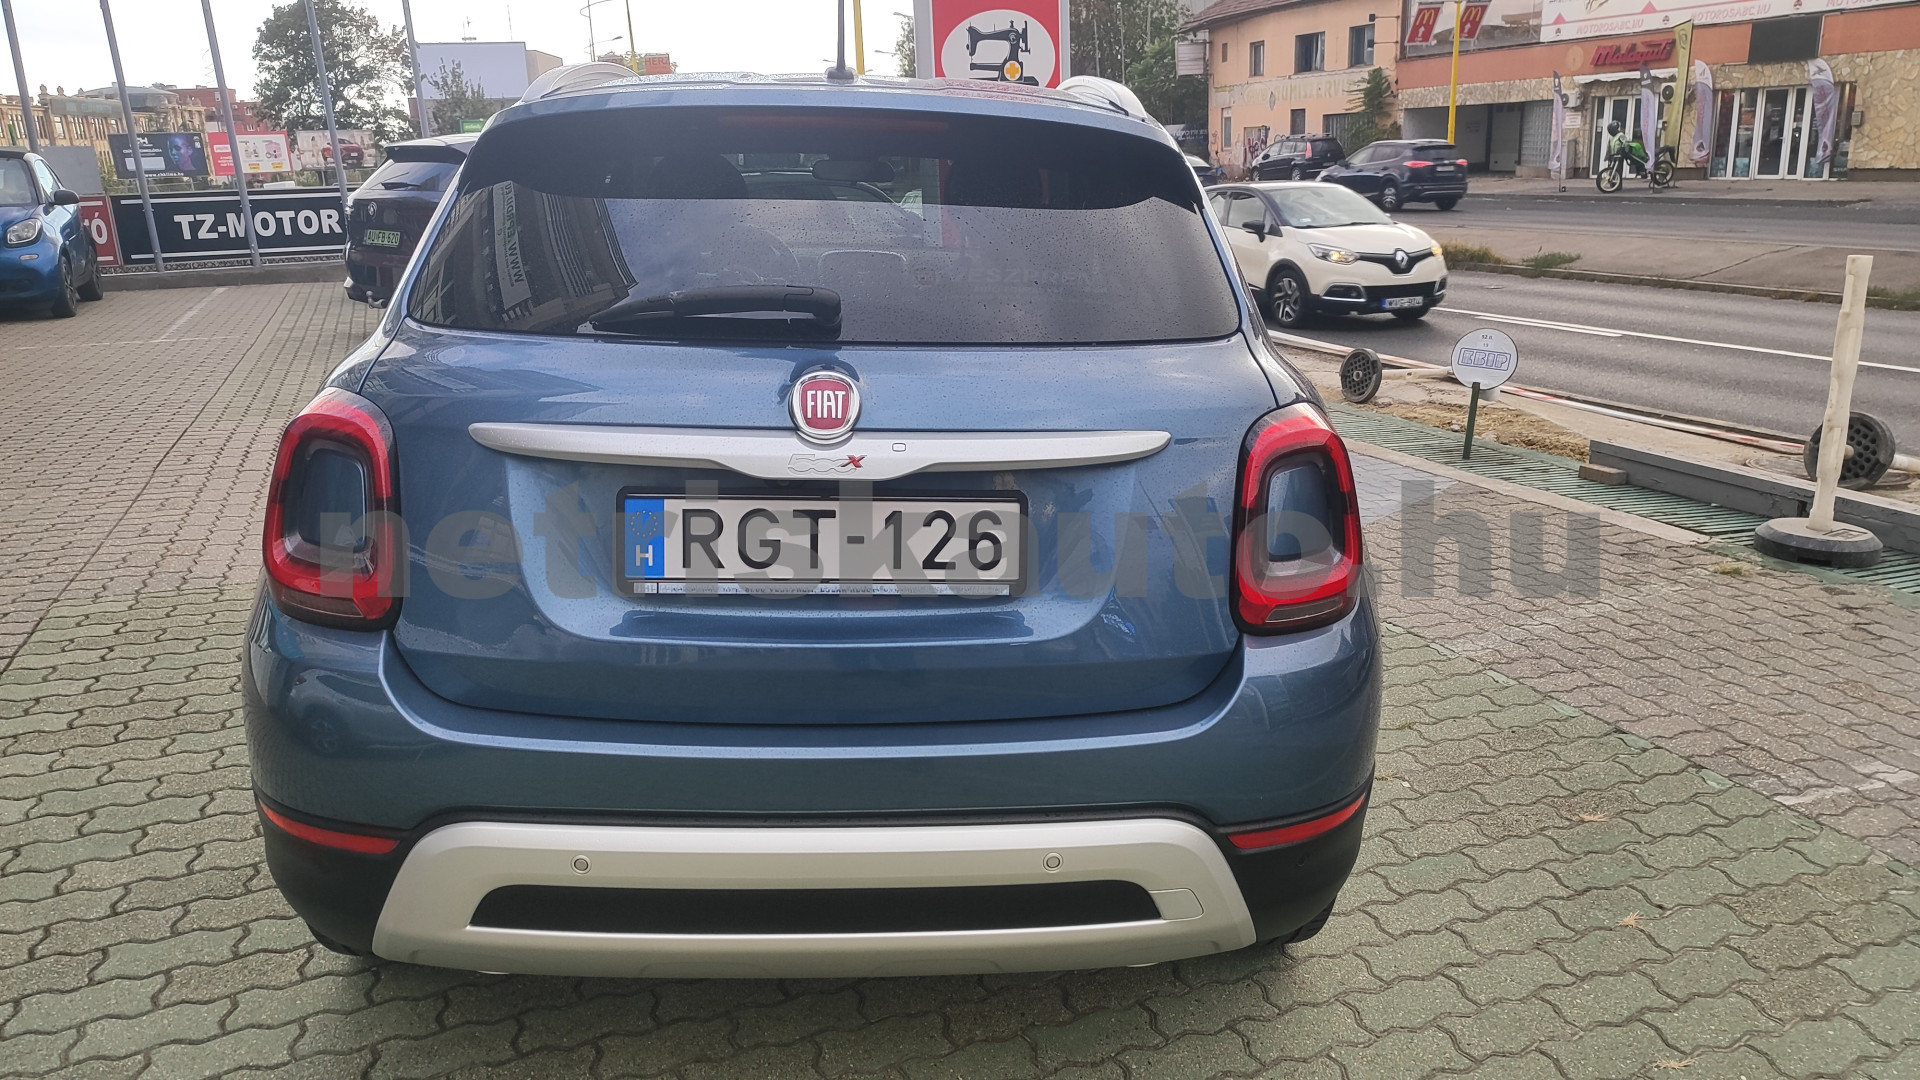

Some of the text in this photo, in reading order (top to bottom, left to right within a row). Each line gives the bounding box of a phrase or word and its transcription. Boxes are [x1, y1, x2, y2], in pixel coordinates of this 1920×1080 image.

[1576, 18, 1644, 35] MOTOROSABC.HU
[1691, 4, 1771, 22] MOTOROSABC.HU
[84, 212, 108, 245] Ó
[173, 208, 343, 240] TZ-MOTOR
[806, 390, 846, 419] FIAT
[681, 507, 1003, 572] RGT-126
[635, 544, 654, 567] H
